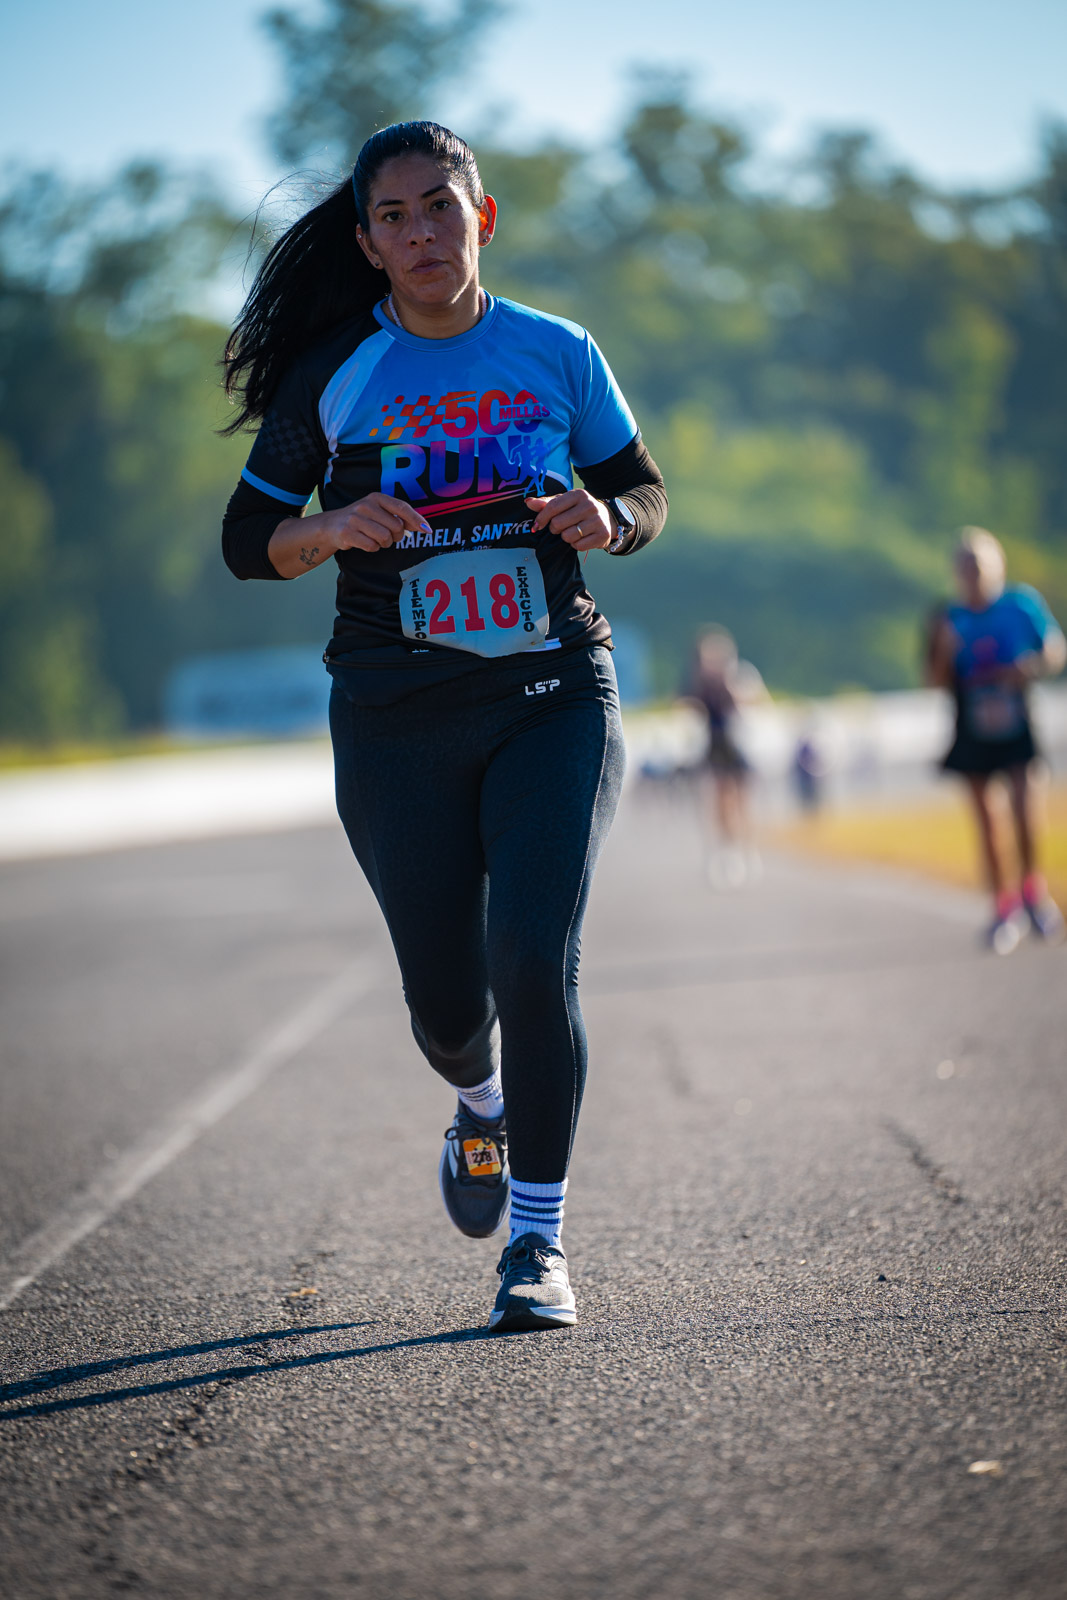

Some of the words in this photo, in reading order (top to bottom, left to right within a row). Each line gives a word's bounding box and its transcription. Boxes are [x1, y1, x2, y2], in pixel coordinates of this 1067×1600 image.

[441, 389, 542, 438] 500
[499, 405, 551, 419] MILLAS
[380, 434, 531, 501] RUN
[409, 578, 427, 640] TIEMPO
[425, 573, 520, 635] 218
[515, 566, 535, 633] EXACTO
